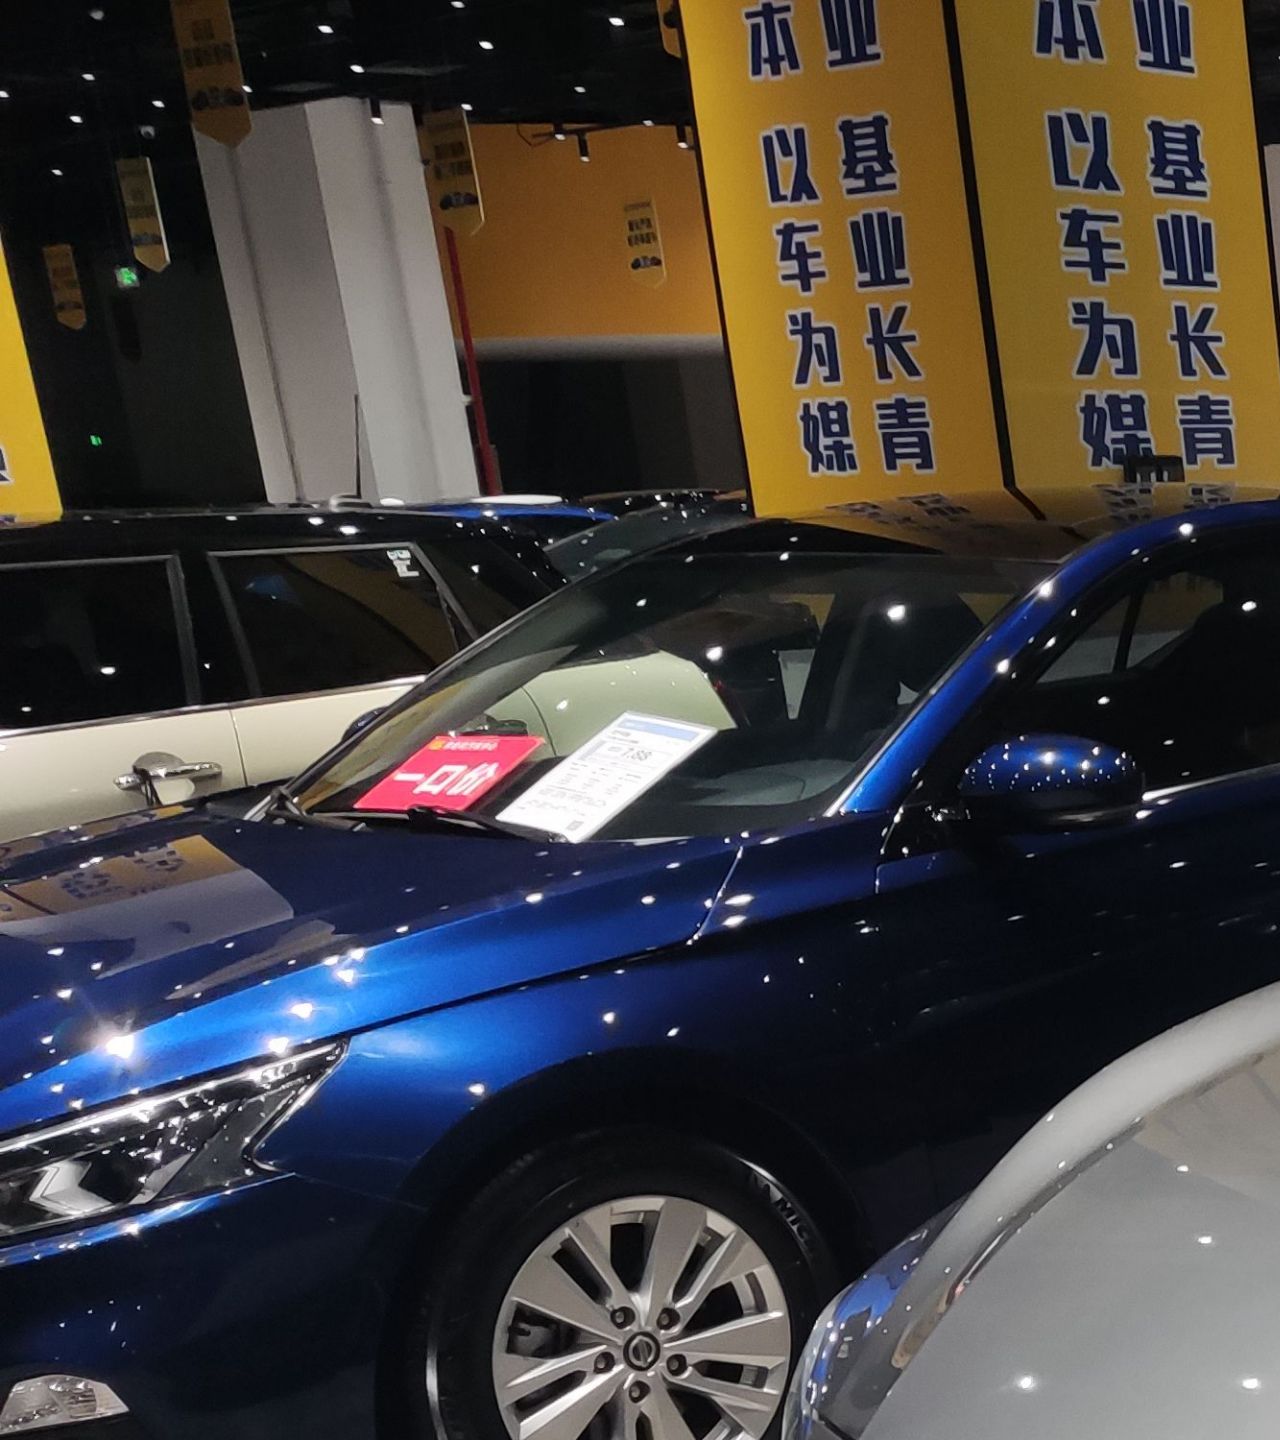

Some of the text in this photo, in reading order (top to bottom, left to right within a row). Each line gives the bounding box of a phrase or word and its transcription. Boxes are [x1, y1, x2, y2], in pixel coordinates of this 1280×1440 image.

[744, 2, 859, 473] 本 以车为媒
[838, 115, 935, 471] 基业长青
[1046, 112, 1154, 467] 以车为媒
[1147, 119, 1236, 466] 基业长青
